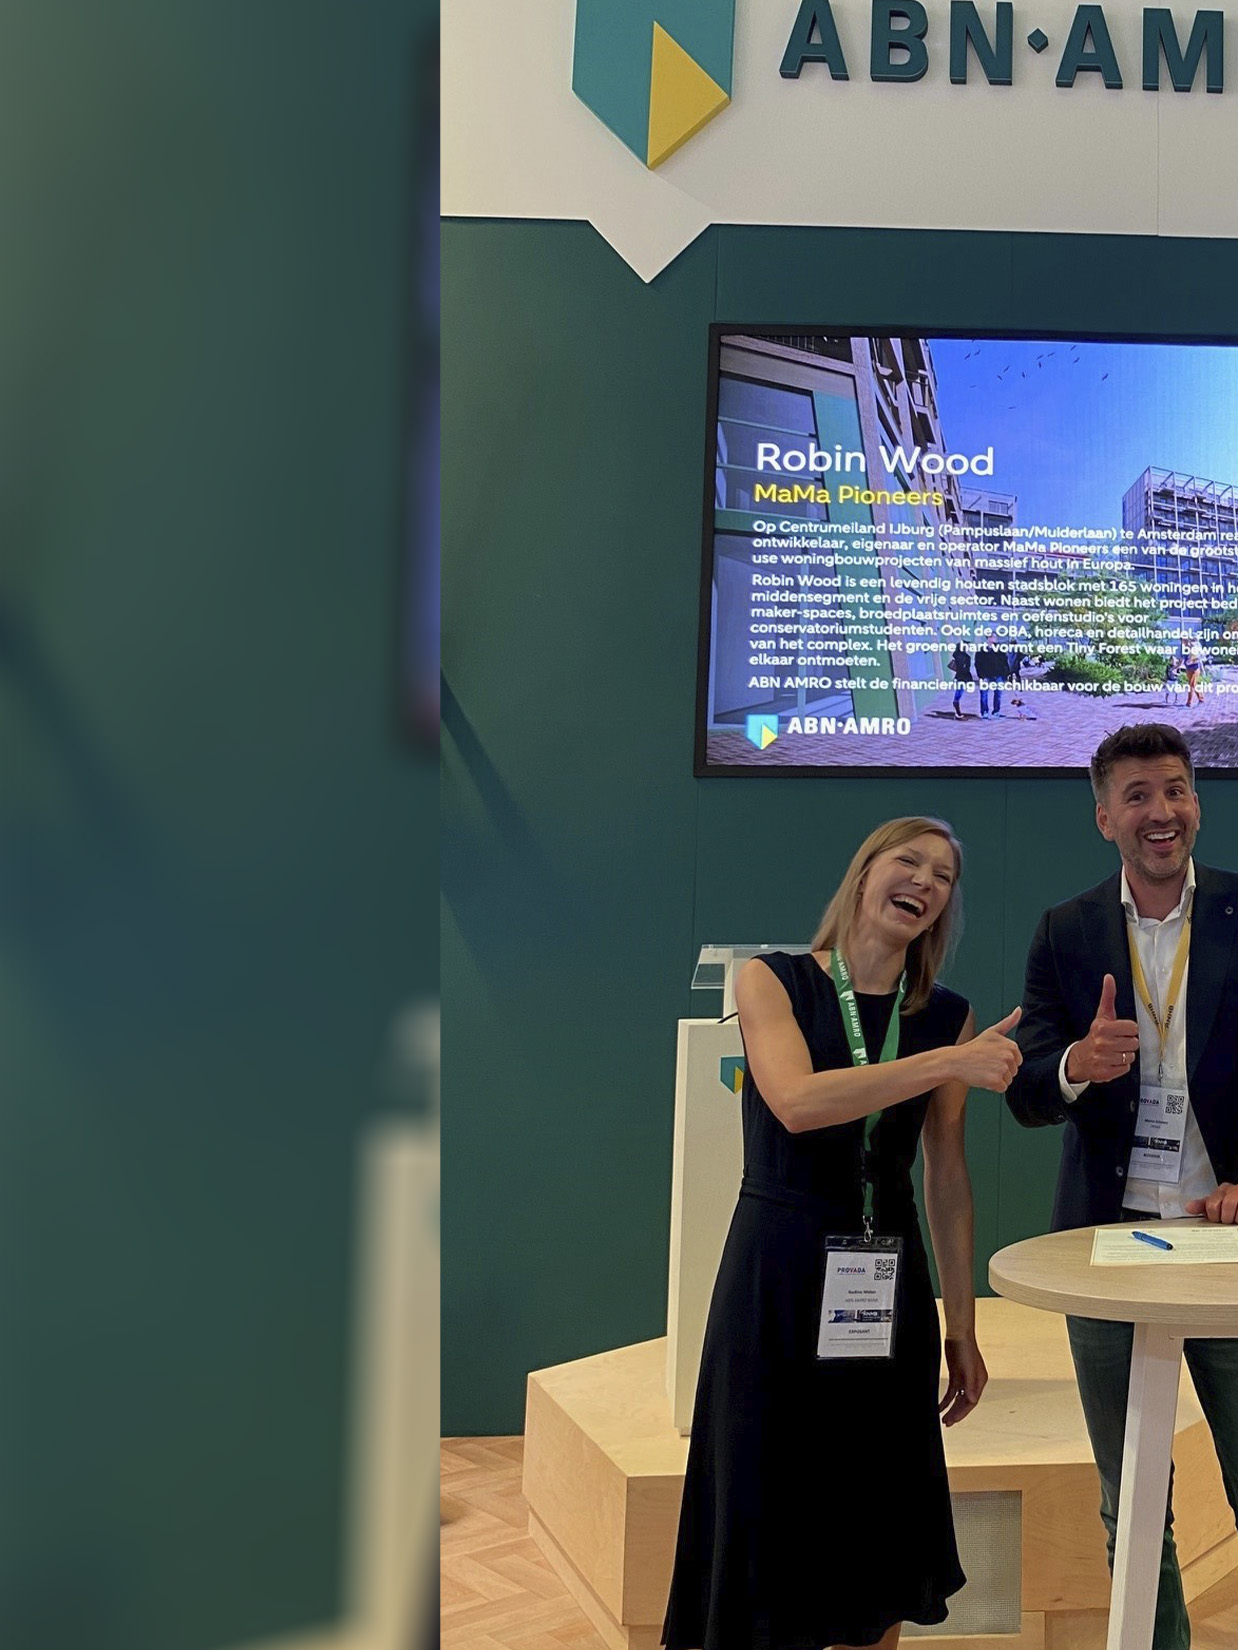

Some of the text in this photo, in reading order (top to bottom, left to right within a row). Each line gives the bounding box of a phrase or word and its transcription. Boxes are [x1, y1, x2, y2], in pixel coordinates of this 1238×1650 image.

[757, 443, 994, 475] Robin Wood
[754, 484, 944, 506] MaMa Pioneers
[753, 521, 776, 533] Op
[779, 521, 885, 534] Centrumeiland
[890, 524, 934, 536] IJburg
[939, 524, 1117, 540] (Pampuslaan/Muiderlaan)
[1121, 530, 1134, 539] te
[1138, 529, 1216, 540] Amsterdam
[753, 537, 848, 550] ontwikkelaar,
[852, 540, 914, 552] eigenaar
[917, 542, 935, 551] en
[938, 541, 999, 554] operator
[1003, 542, 1046, 553] MaMa
[1050, 543, 1108, 554] Pioneers
[1112, 546, 1137, 555] een
[1141, 546, 1166, 556] van
[1169, 545, 1186, 556] de
[752, 553, 1135, 570] use woningbouwprojecten van massief hout in Europa.
[752, 574, 794, 586] Robin
[797, 575, 841, 587] Wood
[846, 577, 856, 587] is
[860, 579, 886, 588] een
[890, 576, 951, 591] levendig
[955, 578, 1004, 590] houten
[1008, 579, 1075, 591] stadsblok
[1079, 581, 1106, 591] met
[1110, 582, 1136, 591] 165
[1140, 582, 1208, 596] woningen
[1212, 583, 1223, 593] in
[752, 591, 869, 605] middensegment
[873, 594, 890, 604] en
[894, 592, 913, 604] de
[917, 594, 947, 607] vrije
[950, 594, 996, 606] sector.
[1001, 595, 1040, 606] Naast
[1043, 597, 1091, 607] wonen
[1094, 596, 1130, 607] biedt
[1134, 597, 1159, 607] het
[1160, 600, 1207, 611] project
[751, 607, 1149, 623] maker-spaces, broedplaatsruimtes en oefenstudio's voor
[750, 623, 937, 636] conservatoriumstudenten.
[940, 624, 970, 636] Ook
[974, 625, 992, 636] de
[996, 626, 1032, 638] OBA,
[1035, 626, 1083, 637] horeca
[1087, 628, 1104, 638] en
[1107, 628, 1197, 640] detailhandel
[1197, 629, 1219, 641] zijn
[750, 640, 777, 650] van
[780, 639, 803, 650] het
[807, 640, 872, 652] complex.
[877, 642, 903, 651] Het
[906, 643, 956, 653] groene
[960, 642, 987, 652] hart
[991, 643, 1034, 653] vormt
[1037, 644, 1063, 653] een
[1066, 642, 1094, 656] Tiny
[1099, 643, 1144, 654] Forest
[1145, 646, 1177, 654] waar
[749, 654, 880, 666] elkaar ontmoeten.
[748, 678, 780, 688] ABN
[784, 678, 832, 689] AMRO
[835, 678, 866, 689] stelt
[870, 679, 889, 690] de
[892, 679, 975, 692] financiering
[979, 680, 1064, 691] beschikbaar
[1067, 682, 1099, 691] voor
[1107, 680, 1120, 691] de
[1124, 681, 1162, 692] bouw
[1167, 683, 1190, 692] van
[1194, 682, 1213, 692] dit
